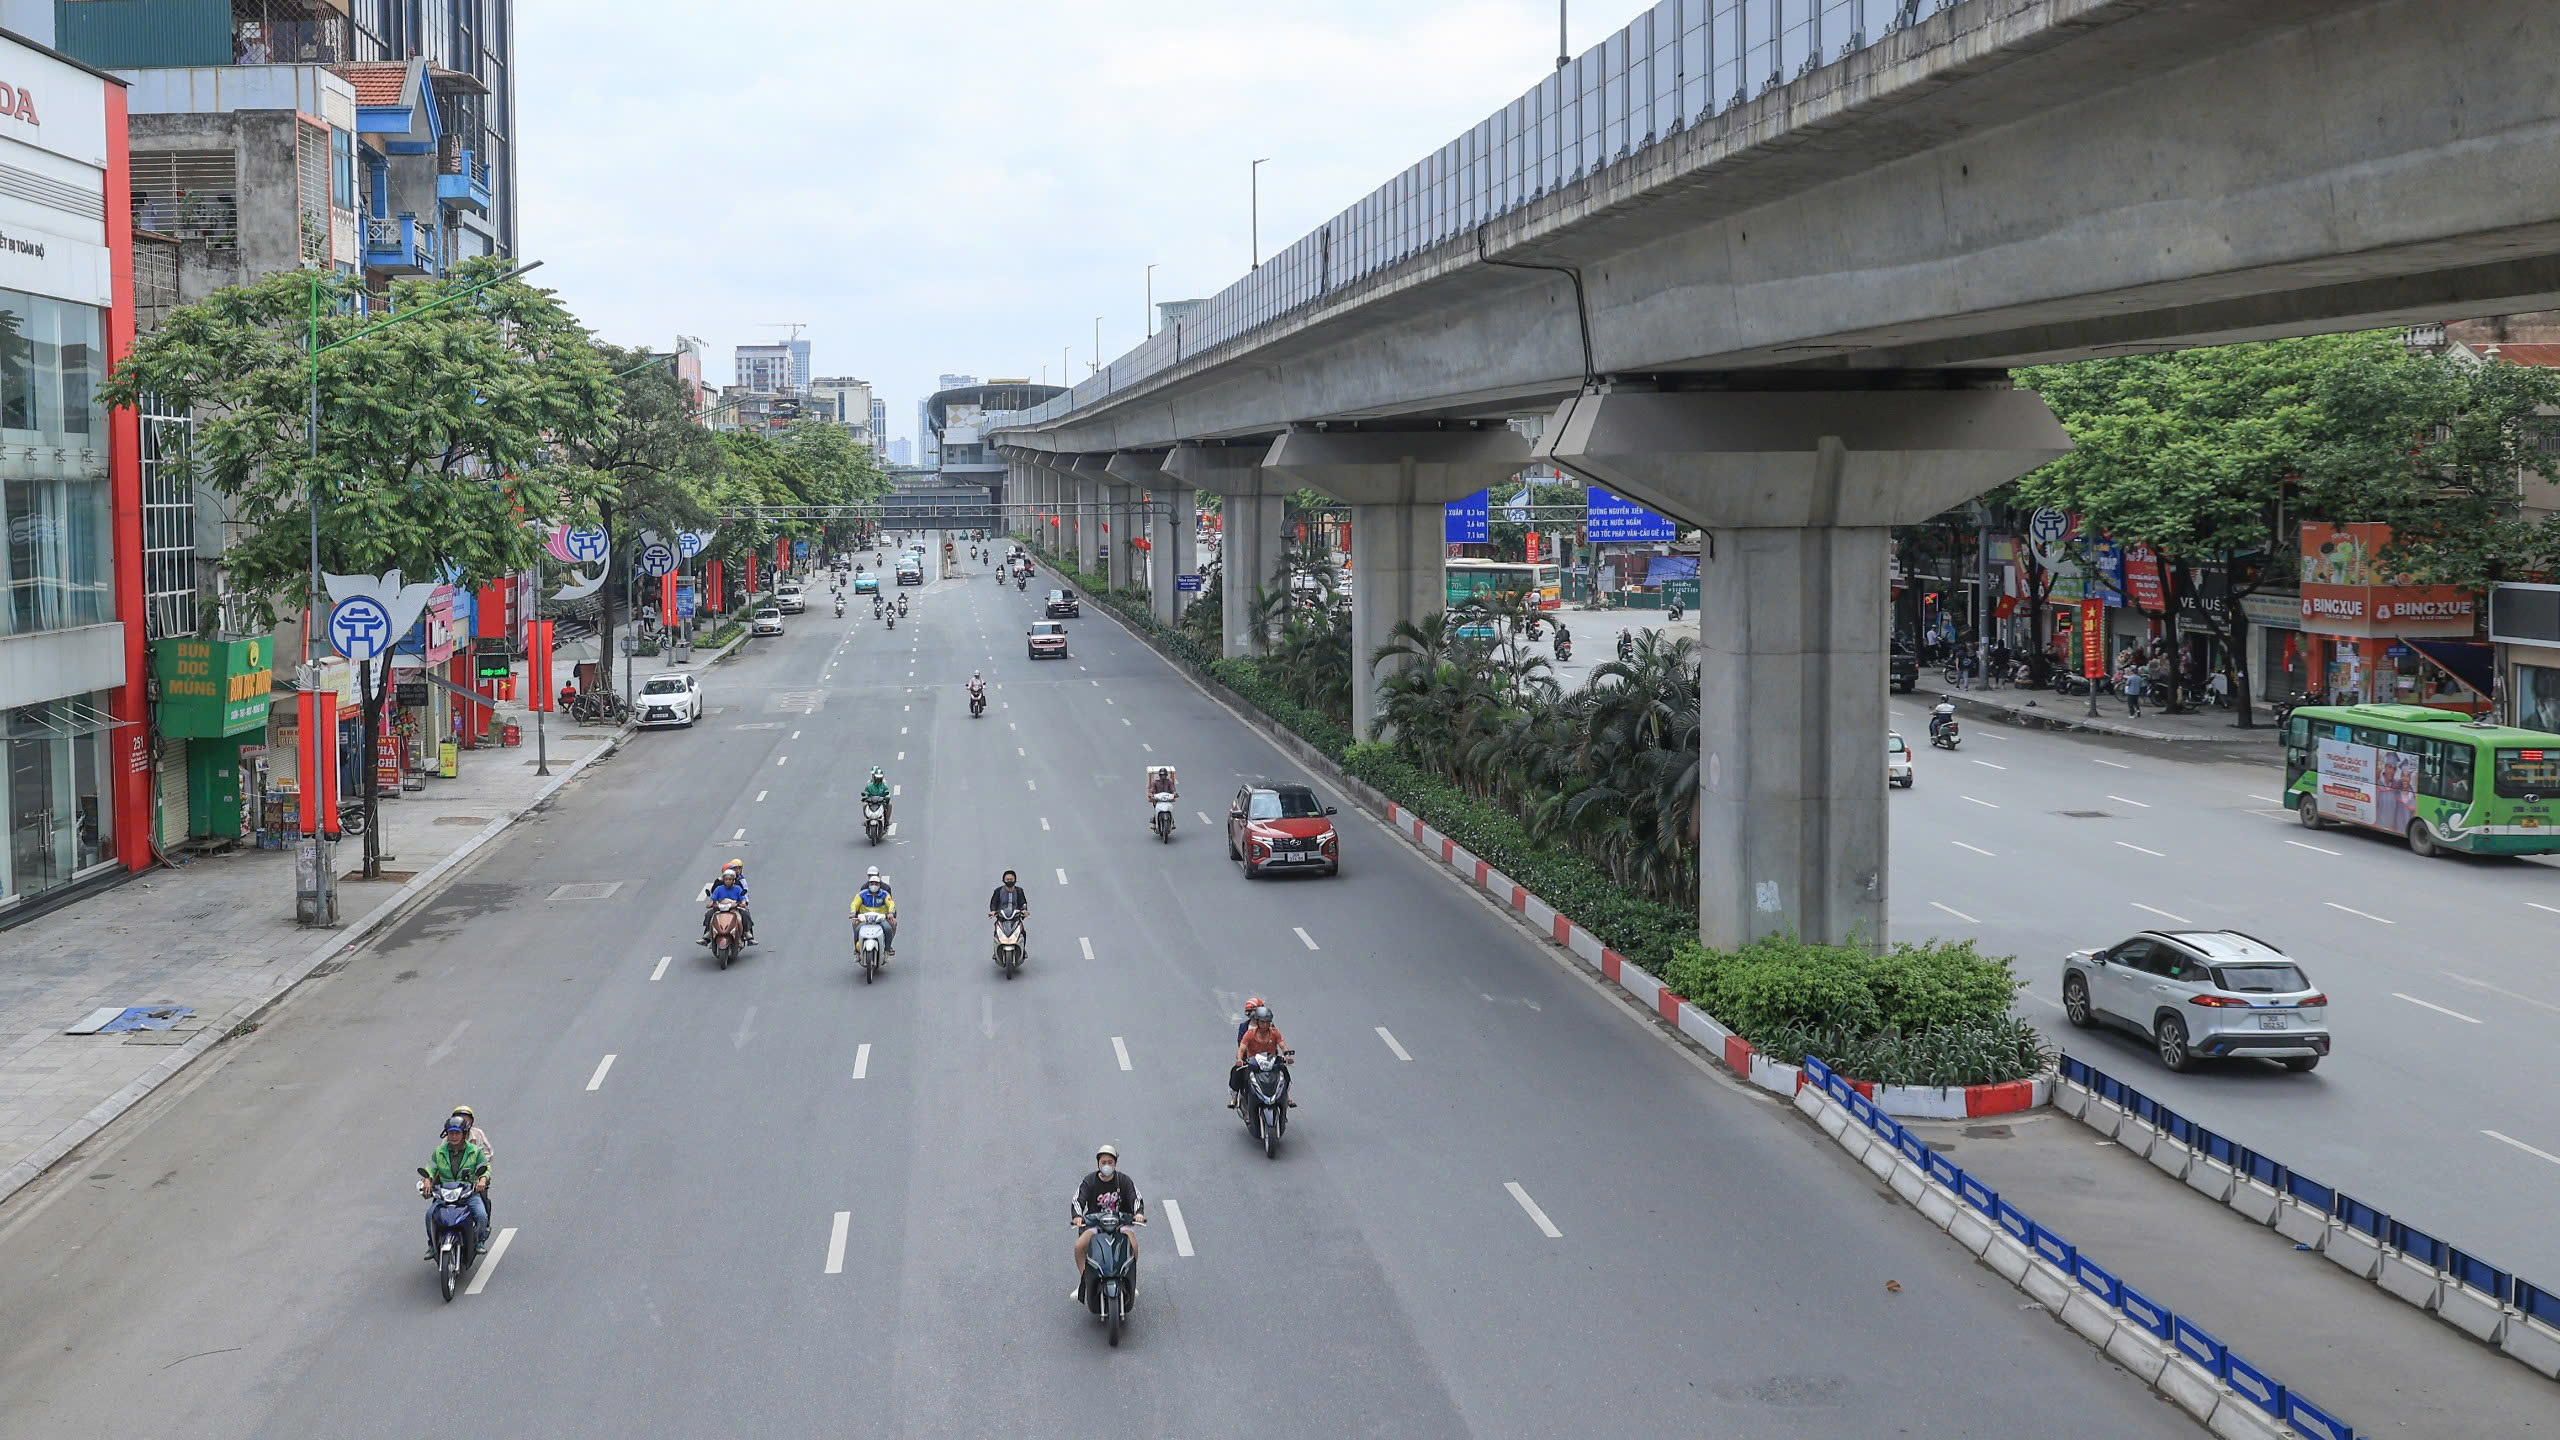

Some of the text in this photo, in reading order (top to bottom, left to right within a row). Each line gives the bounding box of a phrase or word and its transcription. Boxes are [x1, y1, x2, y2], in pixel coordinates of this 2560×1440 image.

[16, 240, 35, 256] TOÀN
[1449, 508, 1463, 516] XUÂN
[1589, 530, 1600, 538] CAO
[1600, 529, 1610, 538] TỐC
[1612, 528, 1626, 538] PHÁP
[2313, 598, 2363, 616] BINGXUE
[2394, 601, 2472, 616] BINGXUE
[133, 736, 144, 750] 251
